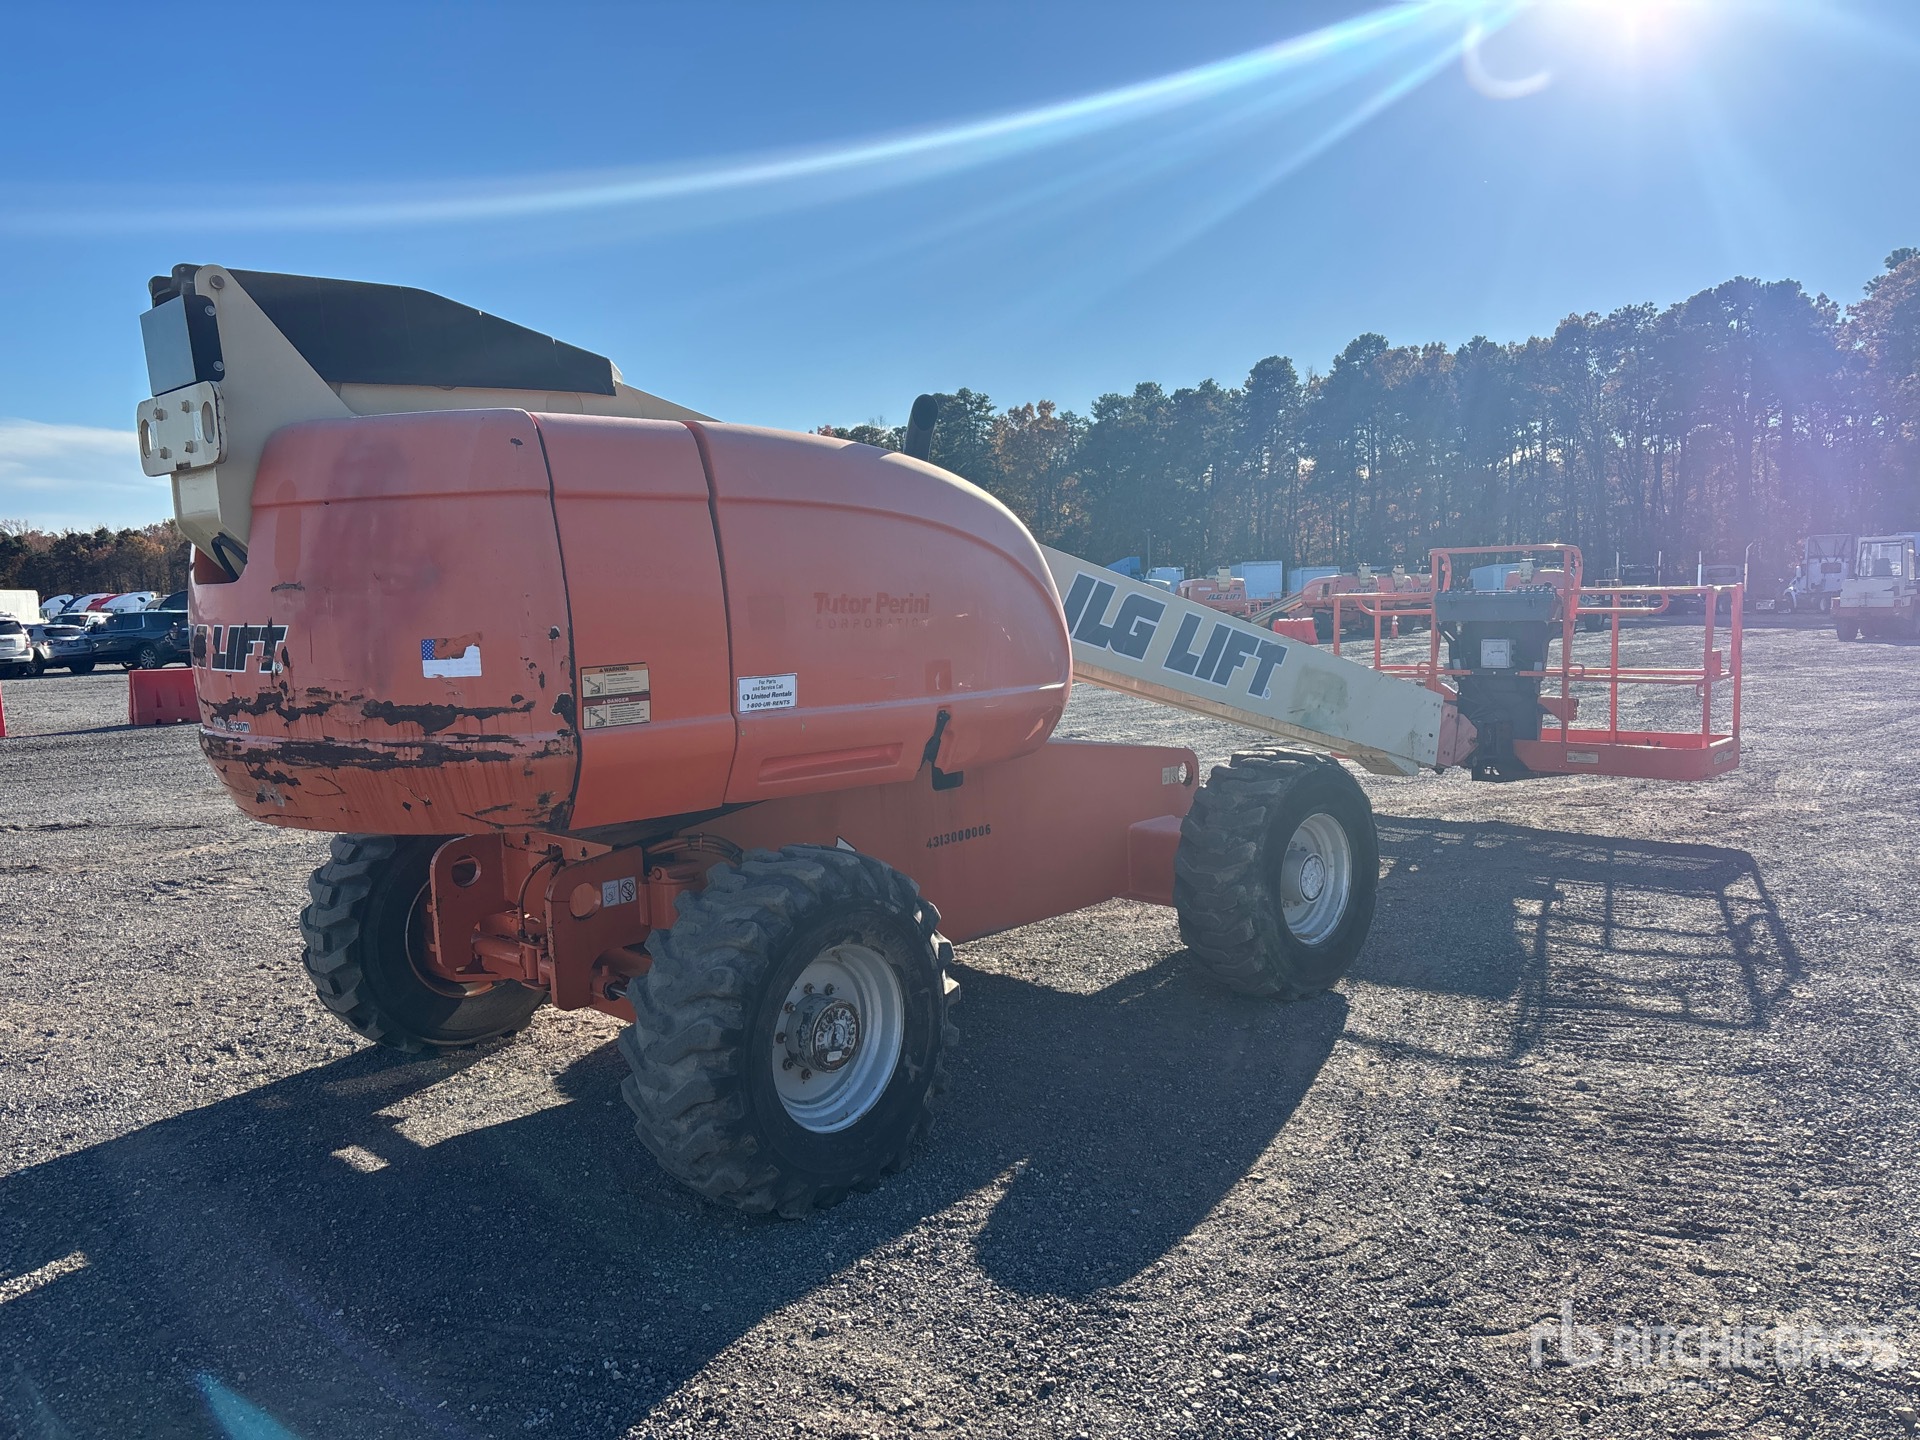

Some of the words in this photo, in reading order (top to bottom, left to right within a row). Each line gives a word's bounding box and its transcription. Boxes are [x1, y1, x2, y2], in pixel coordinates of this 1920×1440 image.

[813, 591, 872, 614] Tutor
[875, 591, 931, 614] Perini
[603, 665, 630, 673] WARNING
[771, 690, 792, 698] Rentals
[926, 823, 991, 849] 4313000006
